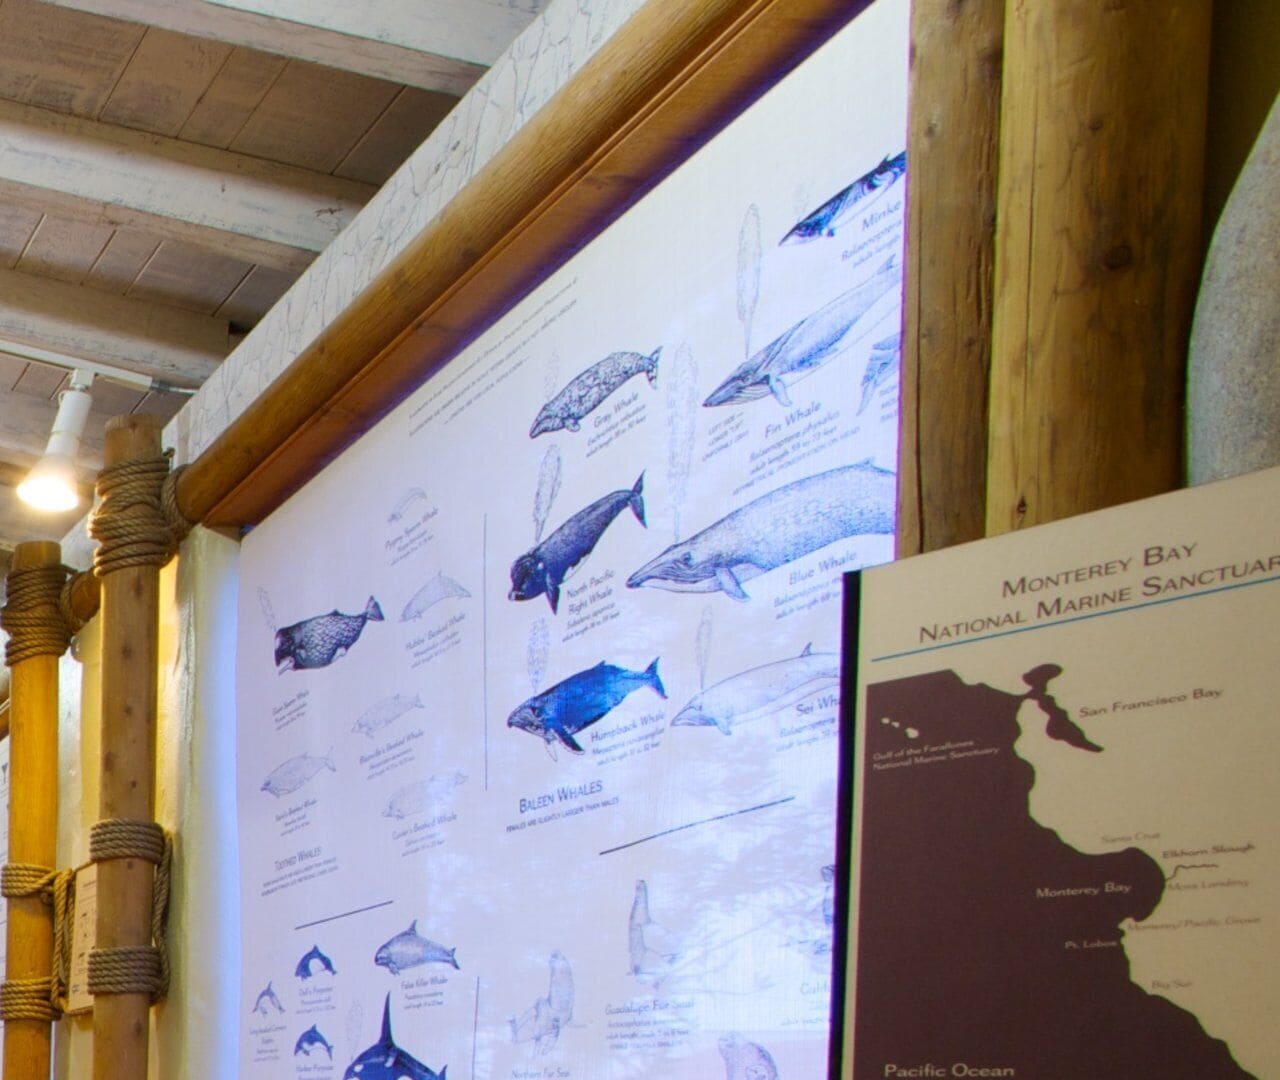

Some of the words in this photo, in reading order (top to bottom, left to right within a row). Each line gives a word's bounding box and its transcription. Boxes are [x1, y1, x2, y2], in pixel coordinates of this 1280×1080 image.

[764, 423, 782, 438] Fin
[784, 401, 821, 426] Whale
[788, 568, 813, 585] Blue
[818, 552, 856, 572] Whale
[1002, 558, 1131, 597] MONTEREY
[1143, 543, 1195, 567] BAY
[1078, 705, 1108, 718] San
[1111, 694, 1187, 712] Francisco
[1192, 687, 1222, 699] Bay
[518, 794, 554, 814] BALEEN
[556, 779, 603, 802] WHALES
[1161, 848, 1208, 859] Elkhorn
[1211, 842, 1255, 854] Slough
[1035, 887, 1099, 898] Monterey
[1103, 881, 1131, 893] Bay
[884, 1062, 945, 1077] Pacific
[951, 1062, 1014, 1077] Ocean
